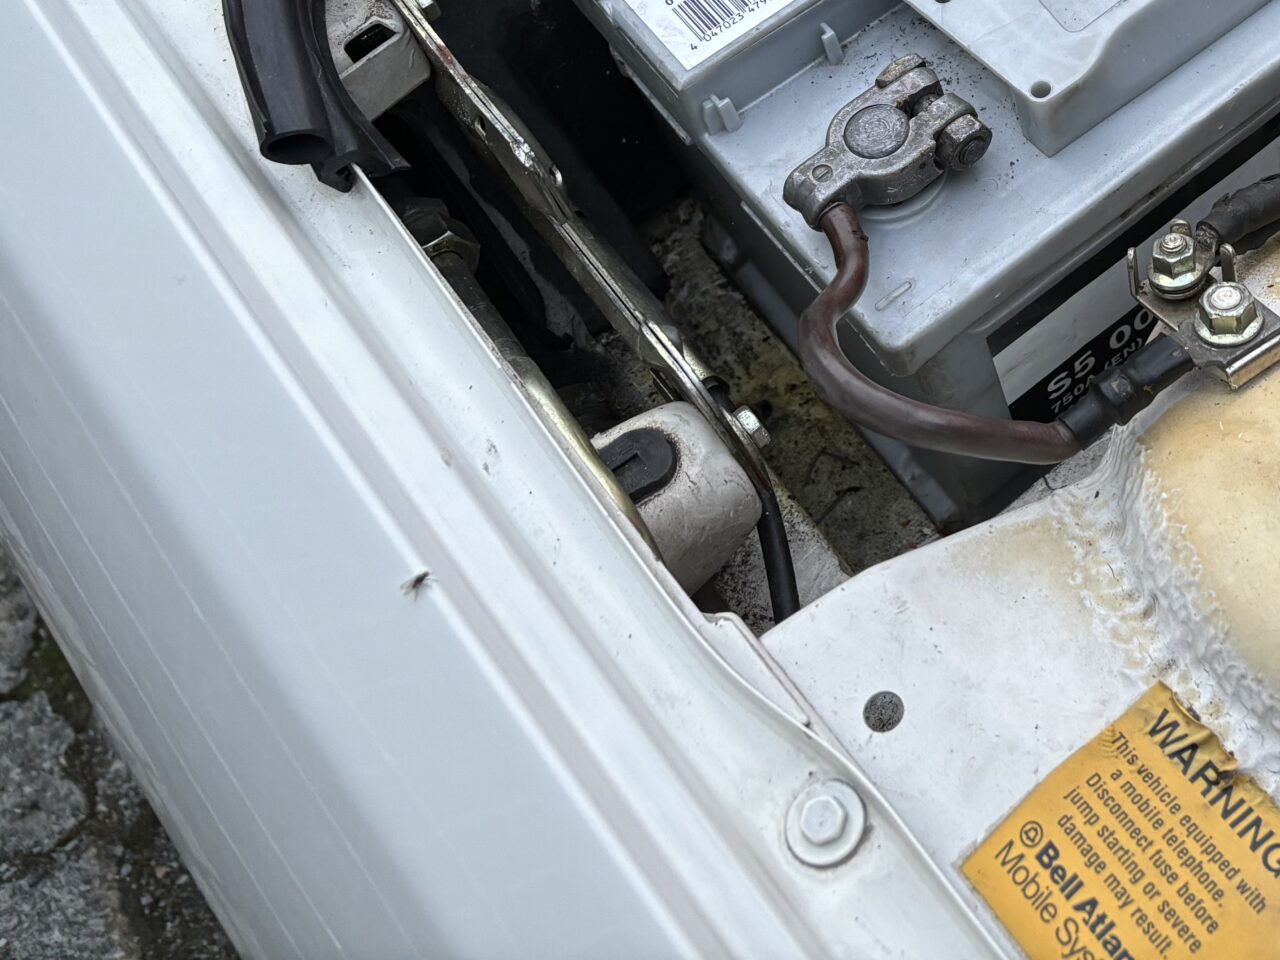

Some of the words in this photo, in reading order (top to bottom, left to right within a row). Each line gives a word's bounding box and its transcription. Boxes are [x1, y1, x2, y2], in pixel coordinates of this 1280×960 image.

[690, 43, 698, 51] 4
[703, 12, 745, 42] 047023
[1047, 349, 1096, 400] S5
[1109, 307, 1154, 350] 00
[994, 838, 1058, 924] Mobile
[1035, 840, 1085, 901] Bell
[1057, 814, 1107, 875] damage
[1103, 873, 1135, 910] may
[1130, 907, 1173, 960] result.
[1063, 785, 1101, 827] jump
[1096, 825, 1146, 886] starting
[1142, 881, 1162, 900] or
[1157, 899, 1202, 954] severe
[1085, 772, 1154, 853] Disconnect
[1149, 849, 1180, 886] fuse
[1175, 881, 1220, 935] before
[1110, 730, 1139, 766] This
[1136, 764, 1182, 816] vehicle
[1179, 814, 1241, 881] equipped
[1236, 878, 1267, 915] with
[1110, 768, 1123, 782] a
[1120, 780, 1165, 830] mobile
[1161, 827, 1225, 908] telephone.
